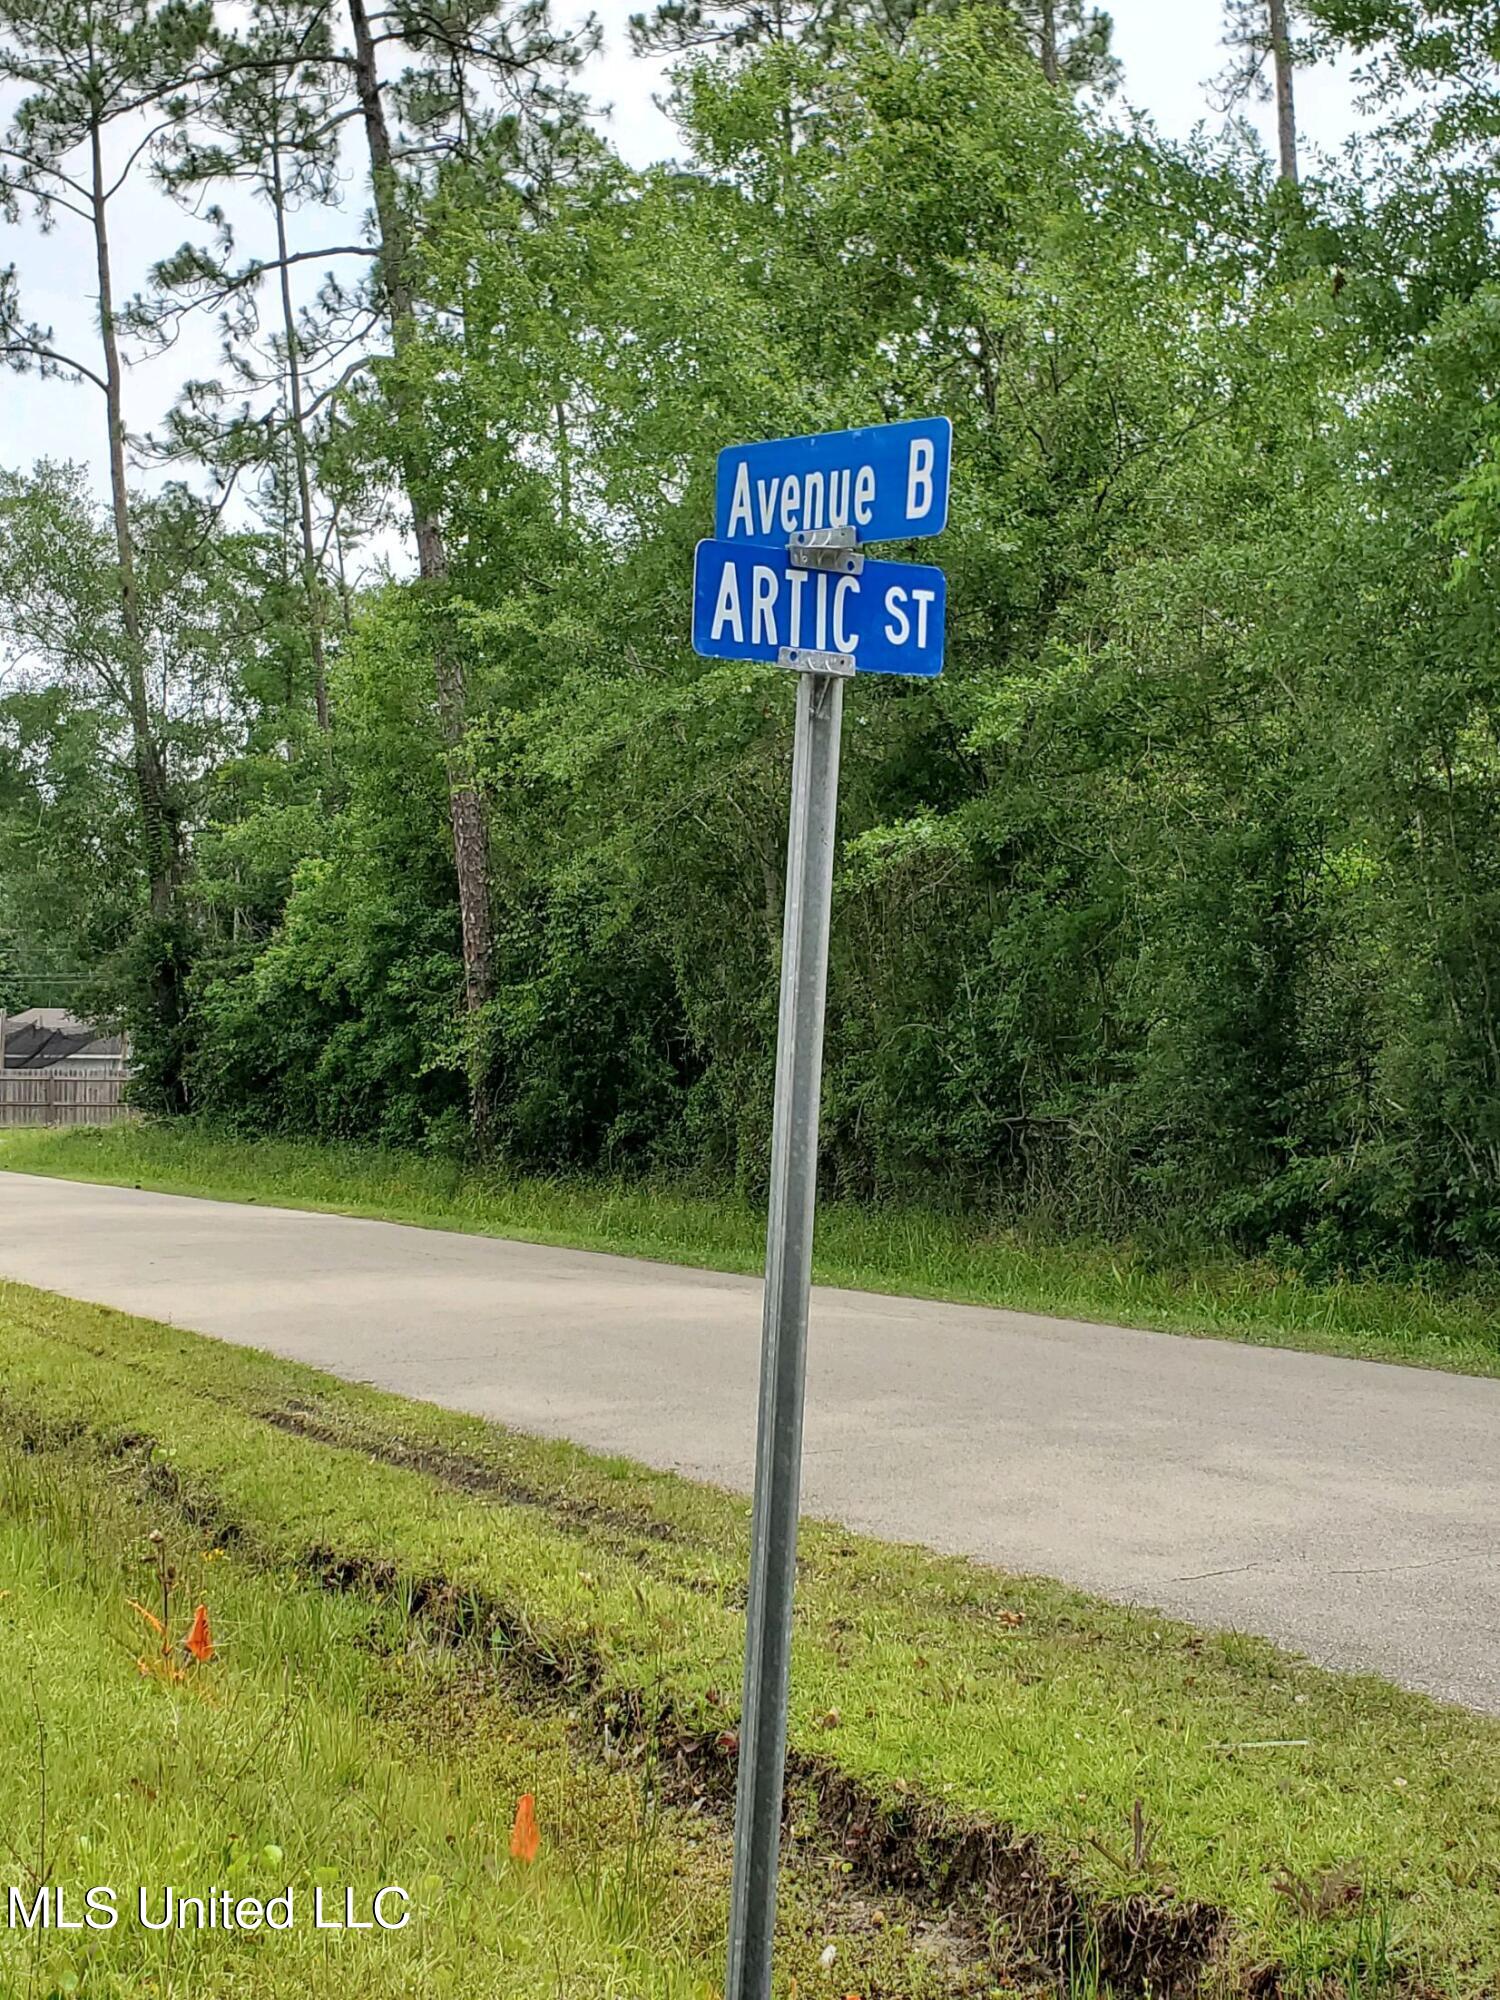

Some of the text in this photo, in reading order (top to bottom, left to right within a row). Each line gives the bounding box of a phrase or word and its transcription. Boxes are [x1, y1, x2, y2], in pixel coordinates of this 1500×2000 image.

[727, 438, 935, 538] Avenue B
[710, 561, 935, 654] ARTIC ST
